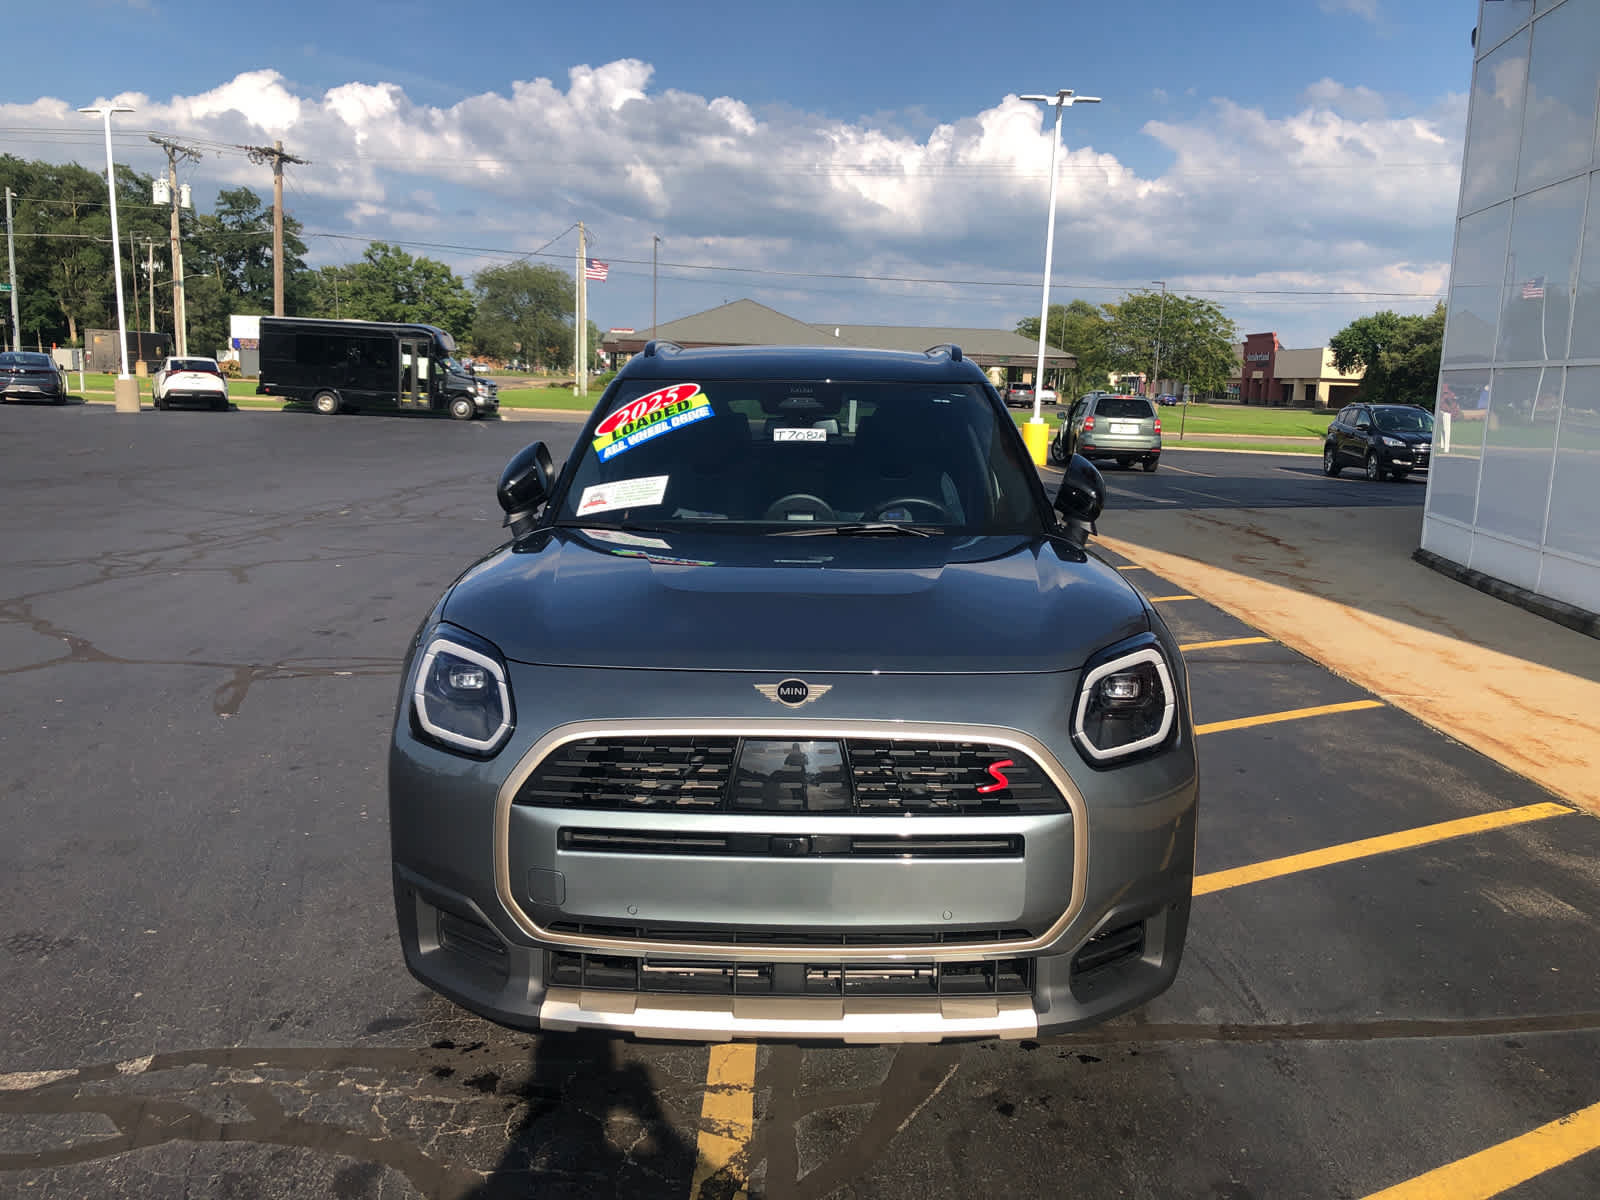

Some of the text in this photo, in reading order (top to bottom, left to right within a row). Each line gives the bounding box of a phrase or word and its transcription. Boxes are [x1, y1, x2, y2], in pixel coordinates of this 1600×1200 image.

[612, 400, 690, 441] LOADED
[614, 386, 680, 430] 2025
[603, 406, 711, 459] ALL WHEEL DRIVE
[780, 687, 806, 696] MINI
[976, 759, 1014, 793] S
